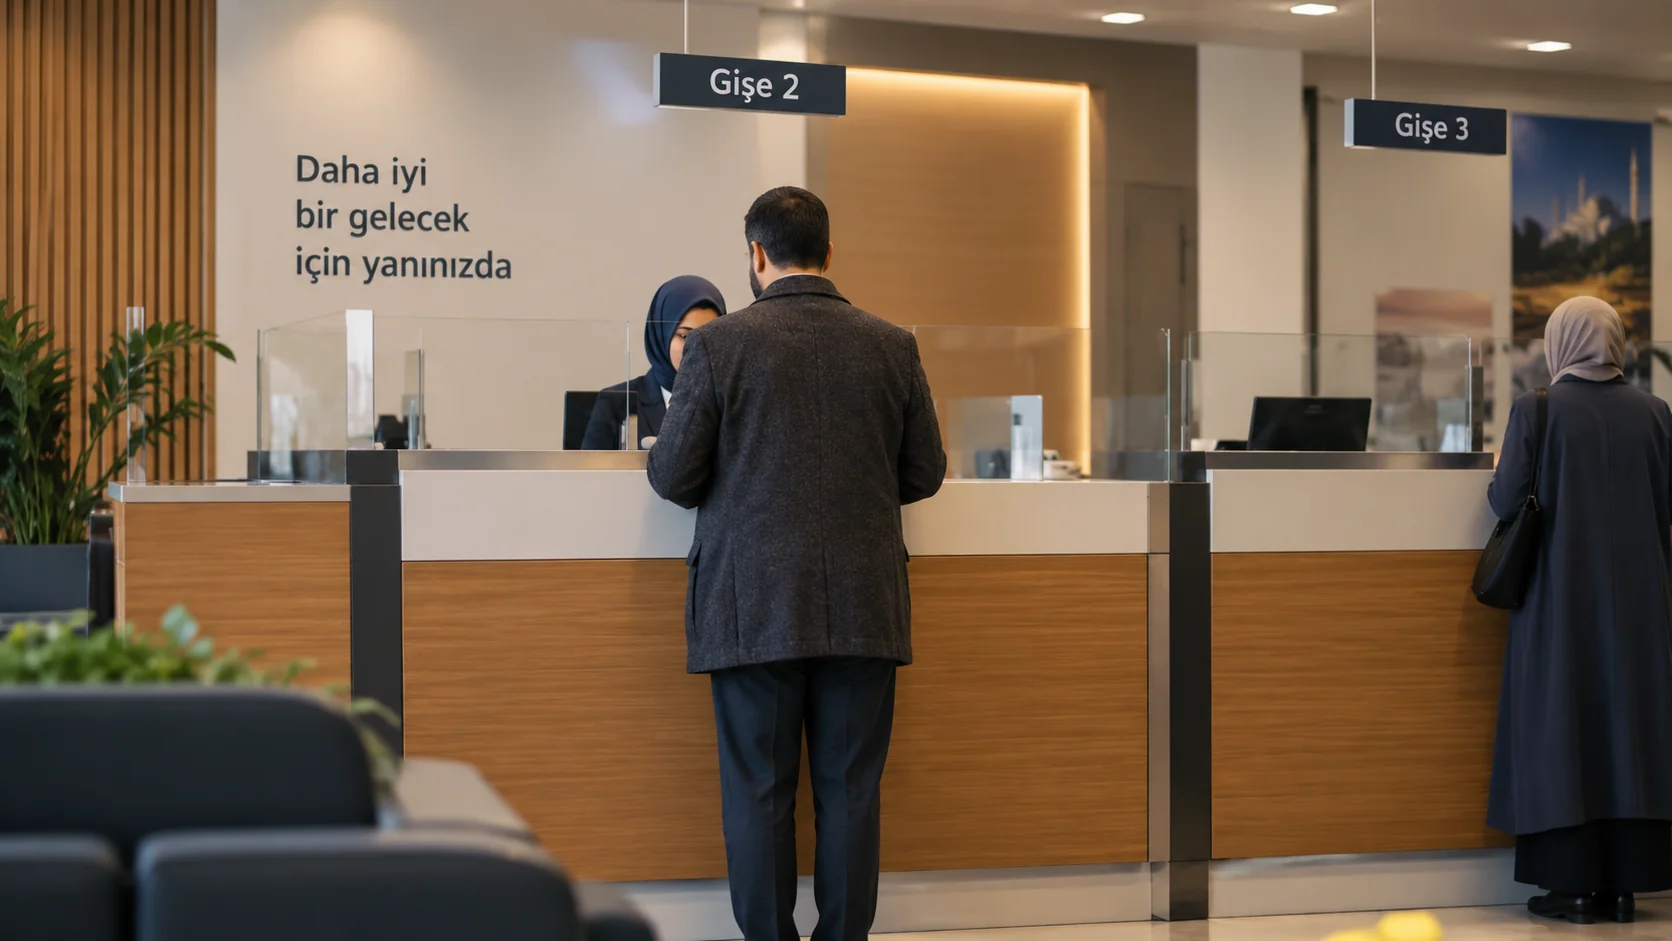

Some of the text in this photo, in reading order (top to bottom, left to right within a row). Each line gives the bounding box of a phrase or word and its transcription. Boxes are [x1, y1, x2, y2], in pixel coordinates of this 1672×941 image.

[709, 68, 799, 103] Gişe 2
[1395, 112, 1469, 144] Gişe 3
[296, 154, 426, 193] Daha iyi
[296, 199, 470, 238] bir gelecek
[296, 246, 512, 285] için yanınızda
